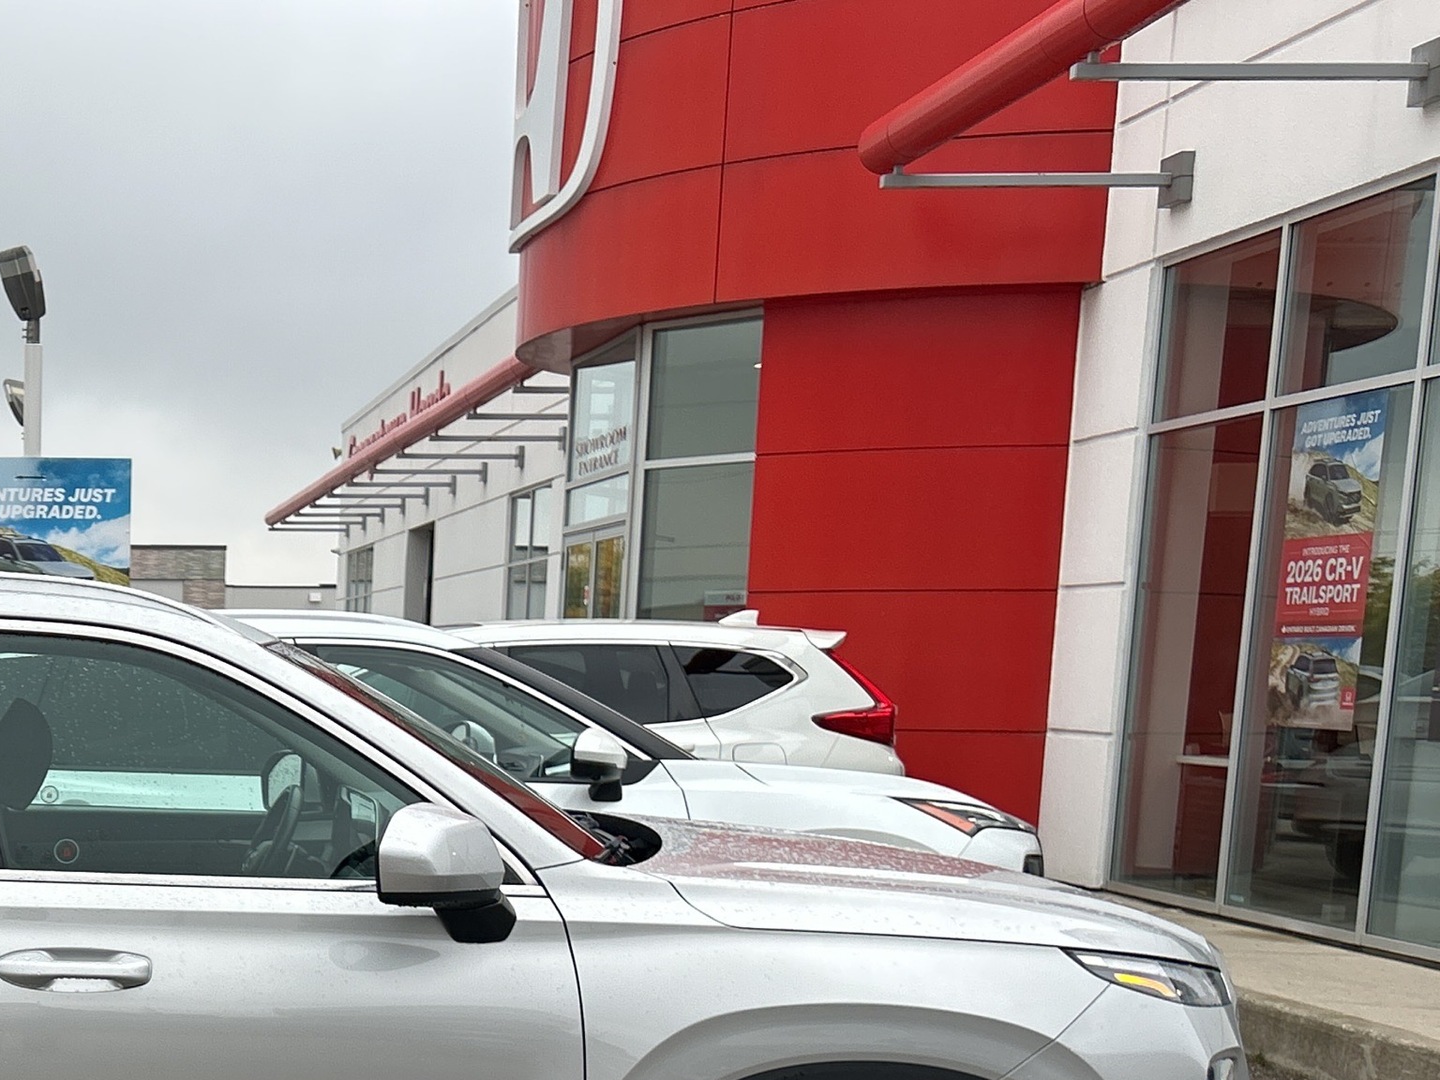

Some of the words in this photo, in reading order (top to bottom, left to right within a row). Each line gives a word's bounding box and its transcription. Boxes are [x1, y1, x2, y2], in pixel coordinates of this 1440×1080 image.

[1301, 413, 1357, 435] ADVENTURES
[1357, 409, 1381, 426] JUST
[1305, 434, 1324, 448] GOT
[68, 488, 116, 503] JUST
[1286, 559, 1323, 583] 2026
[1325, 556, 1364, 581] CR-V
[1285, 583, 1361, 605] TRAILSPORT
